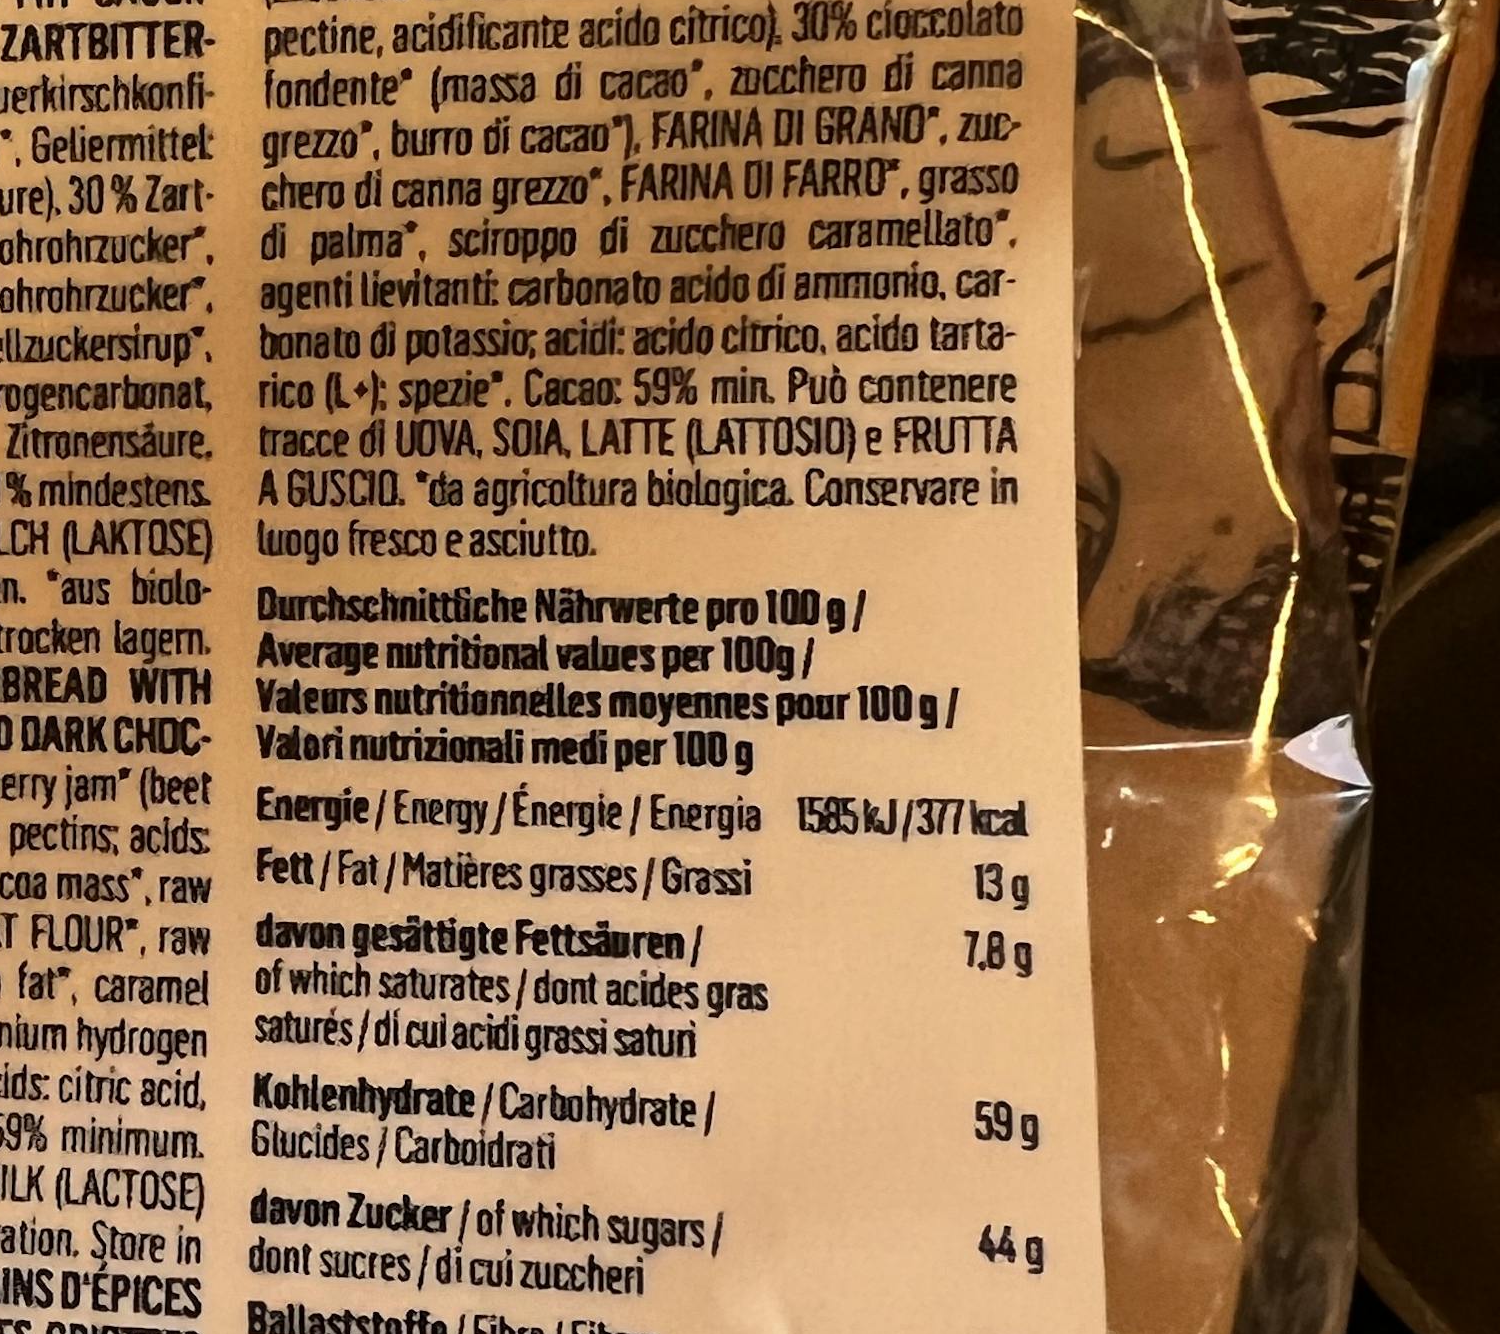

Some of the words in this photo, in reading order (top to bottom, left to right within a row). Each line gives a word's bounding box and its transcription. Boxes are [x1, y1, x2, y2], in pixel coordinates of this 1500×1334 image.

[0, 19, 217, 63] ZARTBITTER-
[259, 424, 350, 459] tracce
[358, 420, 386, 459] di
[581, 417, 677, 458] LATTE
[685, 415, 857, 468] (LATTOSIO)
[864, 426, 883, 457] e
[893, 414, 1018, 455] FRUTTA
[62, 517, 214, 566] (LAKTOSE)
[534, 586, 700, 626] Nährwerte
[705, 597, 760, 633] pro
[764, 588, 821, 626] 100
[825, 597, 846, 635] g
[113, 618, 212, 666] lagern.
[128, 666, 212, 706] WITH
[20, 715, 109, 754] DARK
[113, 715, 213, 757] CHOC-
[256, 785, 369, 832] Energie
[394, 788, 489, 835] Energy
[513, 782, 622, 837] Énergie
[650, 794, 762, 841] Energia
[256, 845, 315, 886] Fett
[337, 848, 380, 887] Fat
[529, 862, 638, 898] grasses
[661, 855, 752, 897] Grassi
[973, 862, 1004, 903] 13
[1010, 874, 1030, 911] g
[255, 911, 346, 951] davon
[351, 914, 509, 962] gesättigte
[515, 918, 686, 961] Fettsäuren
[1013, 941, 1034, 979] g
[252, 1071, 476, 1122] Kohlenhydrate
[498, 1081, 697, 1131] Carbohydrate
[974, 1100, 1014, 1142] 59
[1020, 1113, 1040, 1152] g
[249, 1186, 341, 1228] davon
[345, 1191, 454, 1234] Zucker
[476, 1198, 506, 1238] of
[511, 1201, 600, 1243] which
[606, 1214, 705, 1256] sugars
[977, 1223, 1017, 1264] 44
[1025, 1235, 1045, 1275] g
